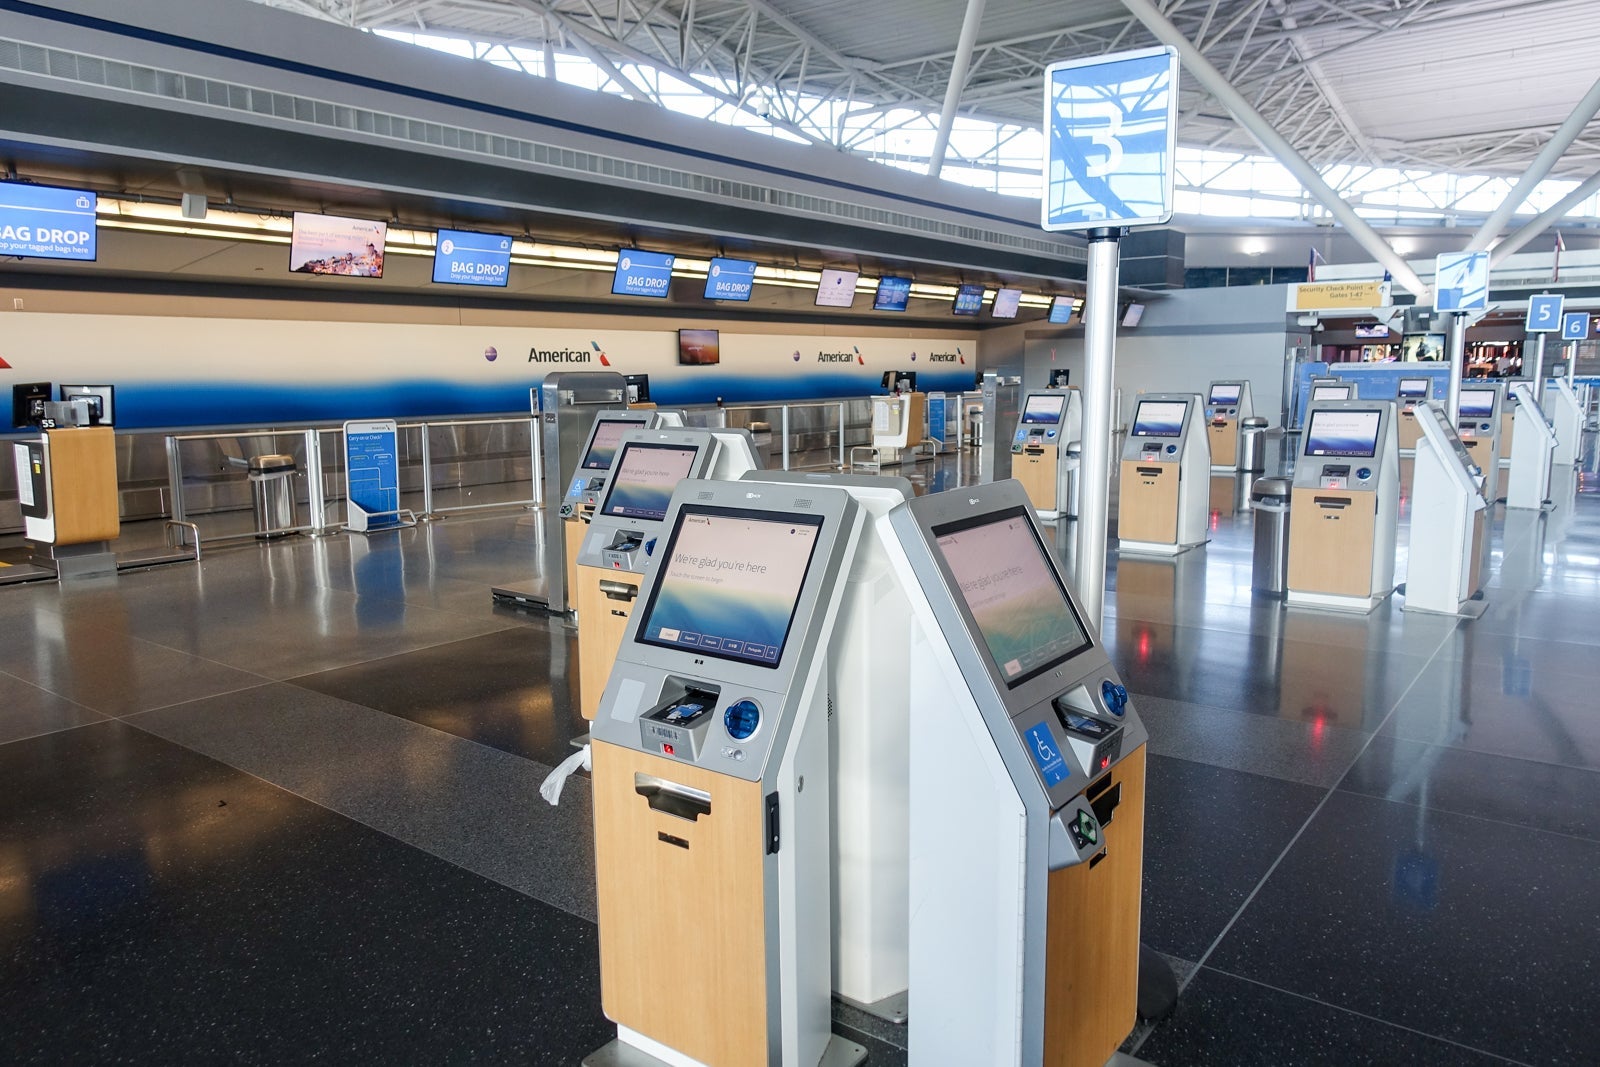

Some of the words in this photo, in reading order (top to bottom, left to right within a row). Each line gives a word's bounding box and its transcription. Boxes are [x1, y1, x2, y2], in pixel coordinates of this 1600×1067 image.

[1086, 101, 1124, 178] 3
[0, 225, 31, 242] AG
[36, 227, 90, 246] DROP
[29, 244, 54, 253] tagged
[55, 245, 71, 254] bags
[73, 246, 89, 254] here
[451, 261, 474, 274] BAG
[476, 263, 506, 276] DROP
[626, 276, 644, 287] BAG
[645, 277, 668, 289] DROP
[716, 282, 731, 292] BAG
[731, 282, 750, 293] DROP
[1539, 304, 1551, 321] 5
[1570, 320, 1581, 333] 6
[528, 348, 591, 363] American
[818, 351, 853, 363] American
[929, 352, 957, 363] American
[42, 419, 56, 428] 55
[675, 553, 698, 566] We're
[698, 556, 718, 569] glad
[717, 559, 745, 571] you're
[746, 561, 767, 574] here
